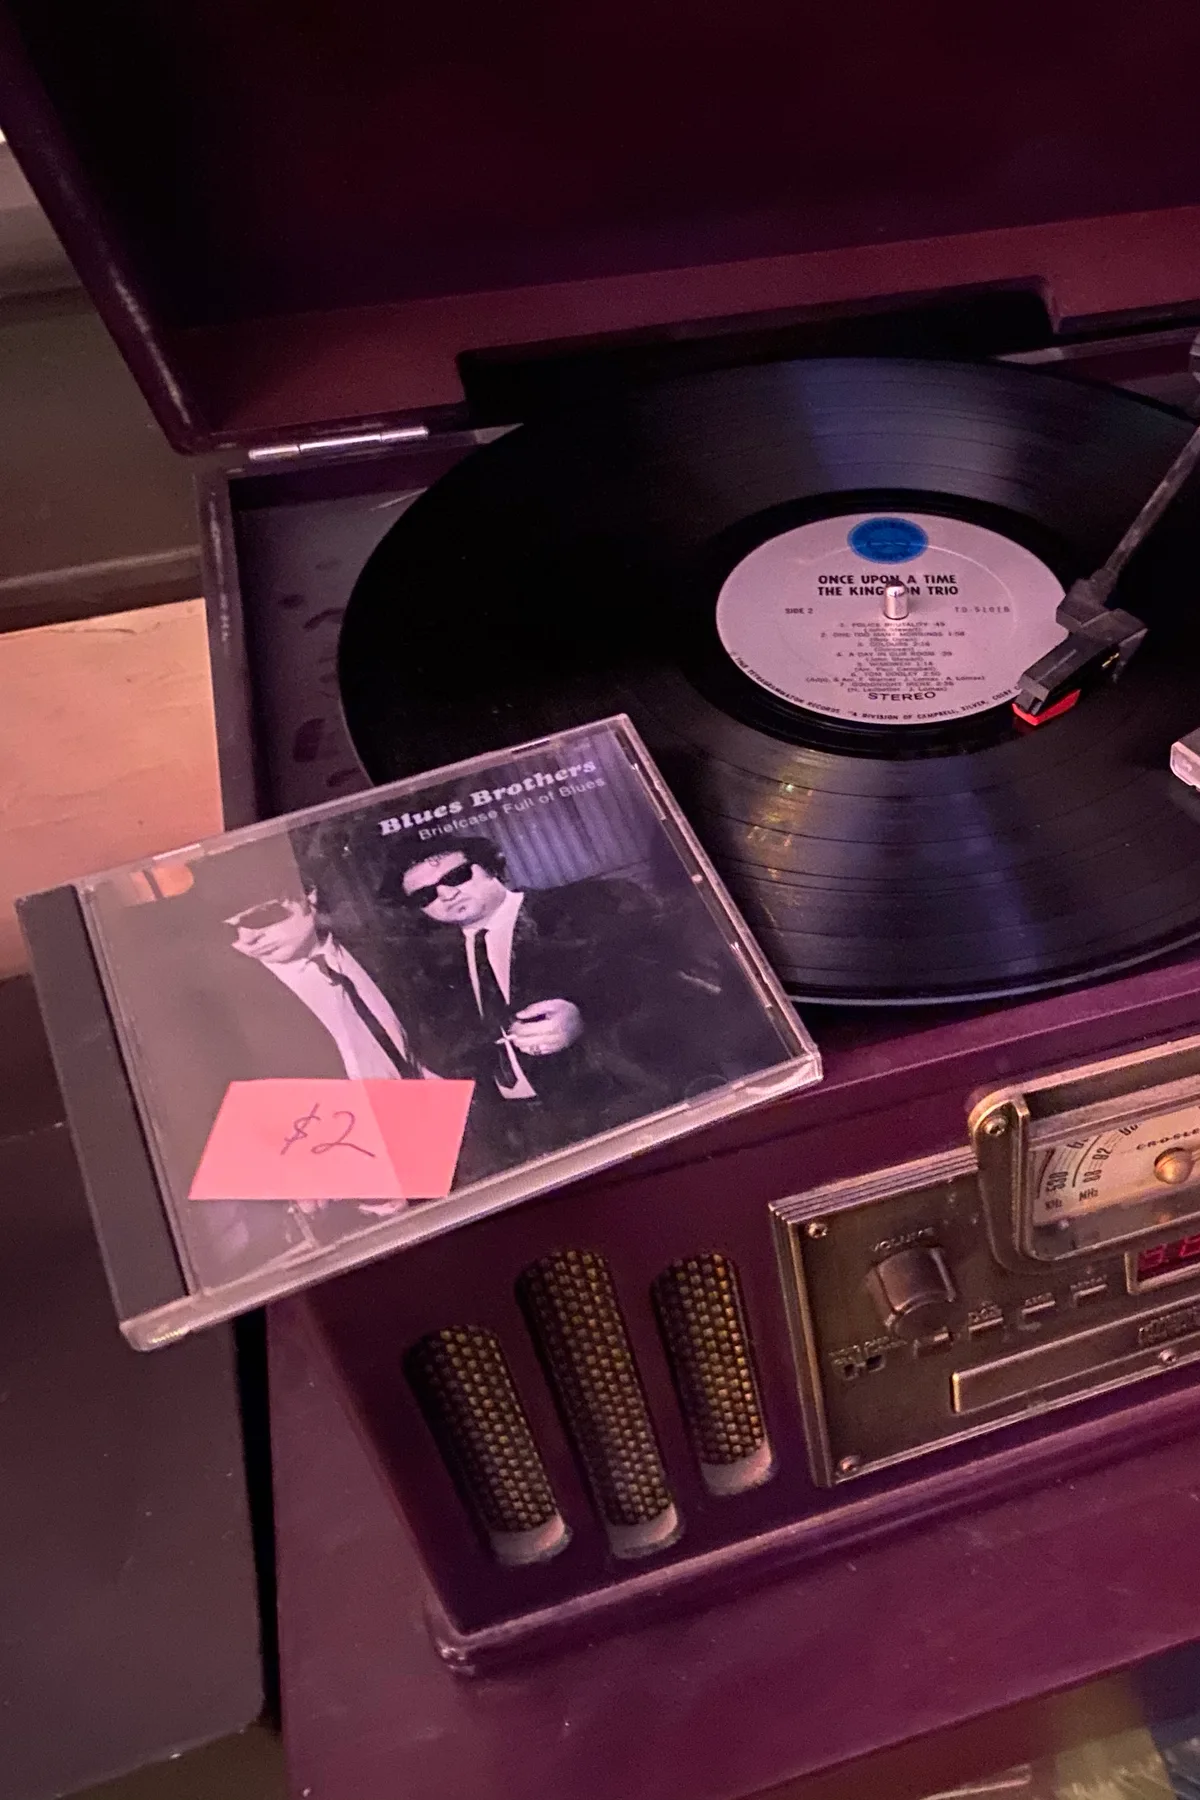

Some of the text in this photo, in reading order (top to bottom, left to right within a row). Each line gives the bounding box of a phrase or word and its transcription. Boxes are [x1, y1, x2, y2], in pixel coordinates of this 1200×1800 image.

[818, 574, 957, 585] ONCE UPON A TIME
[818, 586, 958, 596] THE KINGN TRIO
[785, 607, 804, 615] SIDE
[868, 691, 937, 701] STEREO
[378, 760, 597, 836] Blues Brothers
[418, 777, 607, 841] Briefcase Full of Blues
[280, 1102, 377, 1158] $2
[1078, 1187, 1100, 1203] MHz
